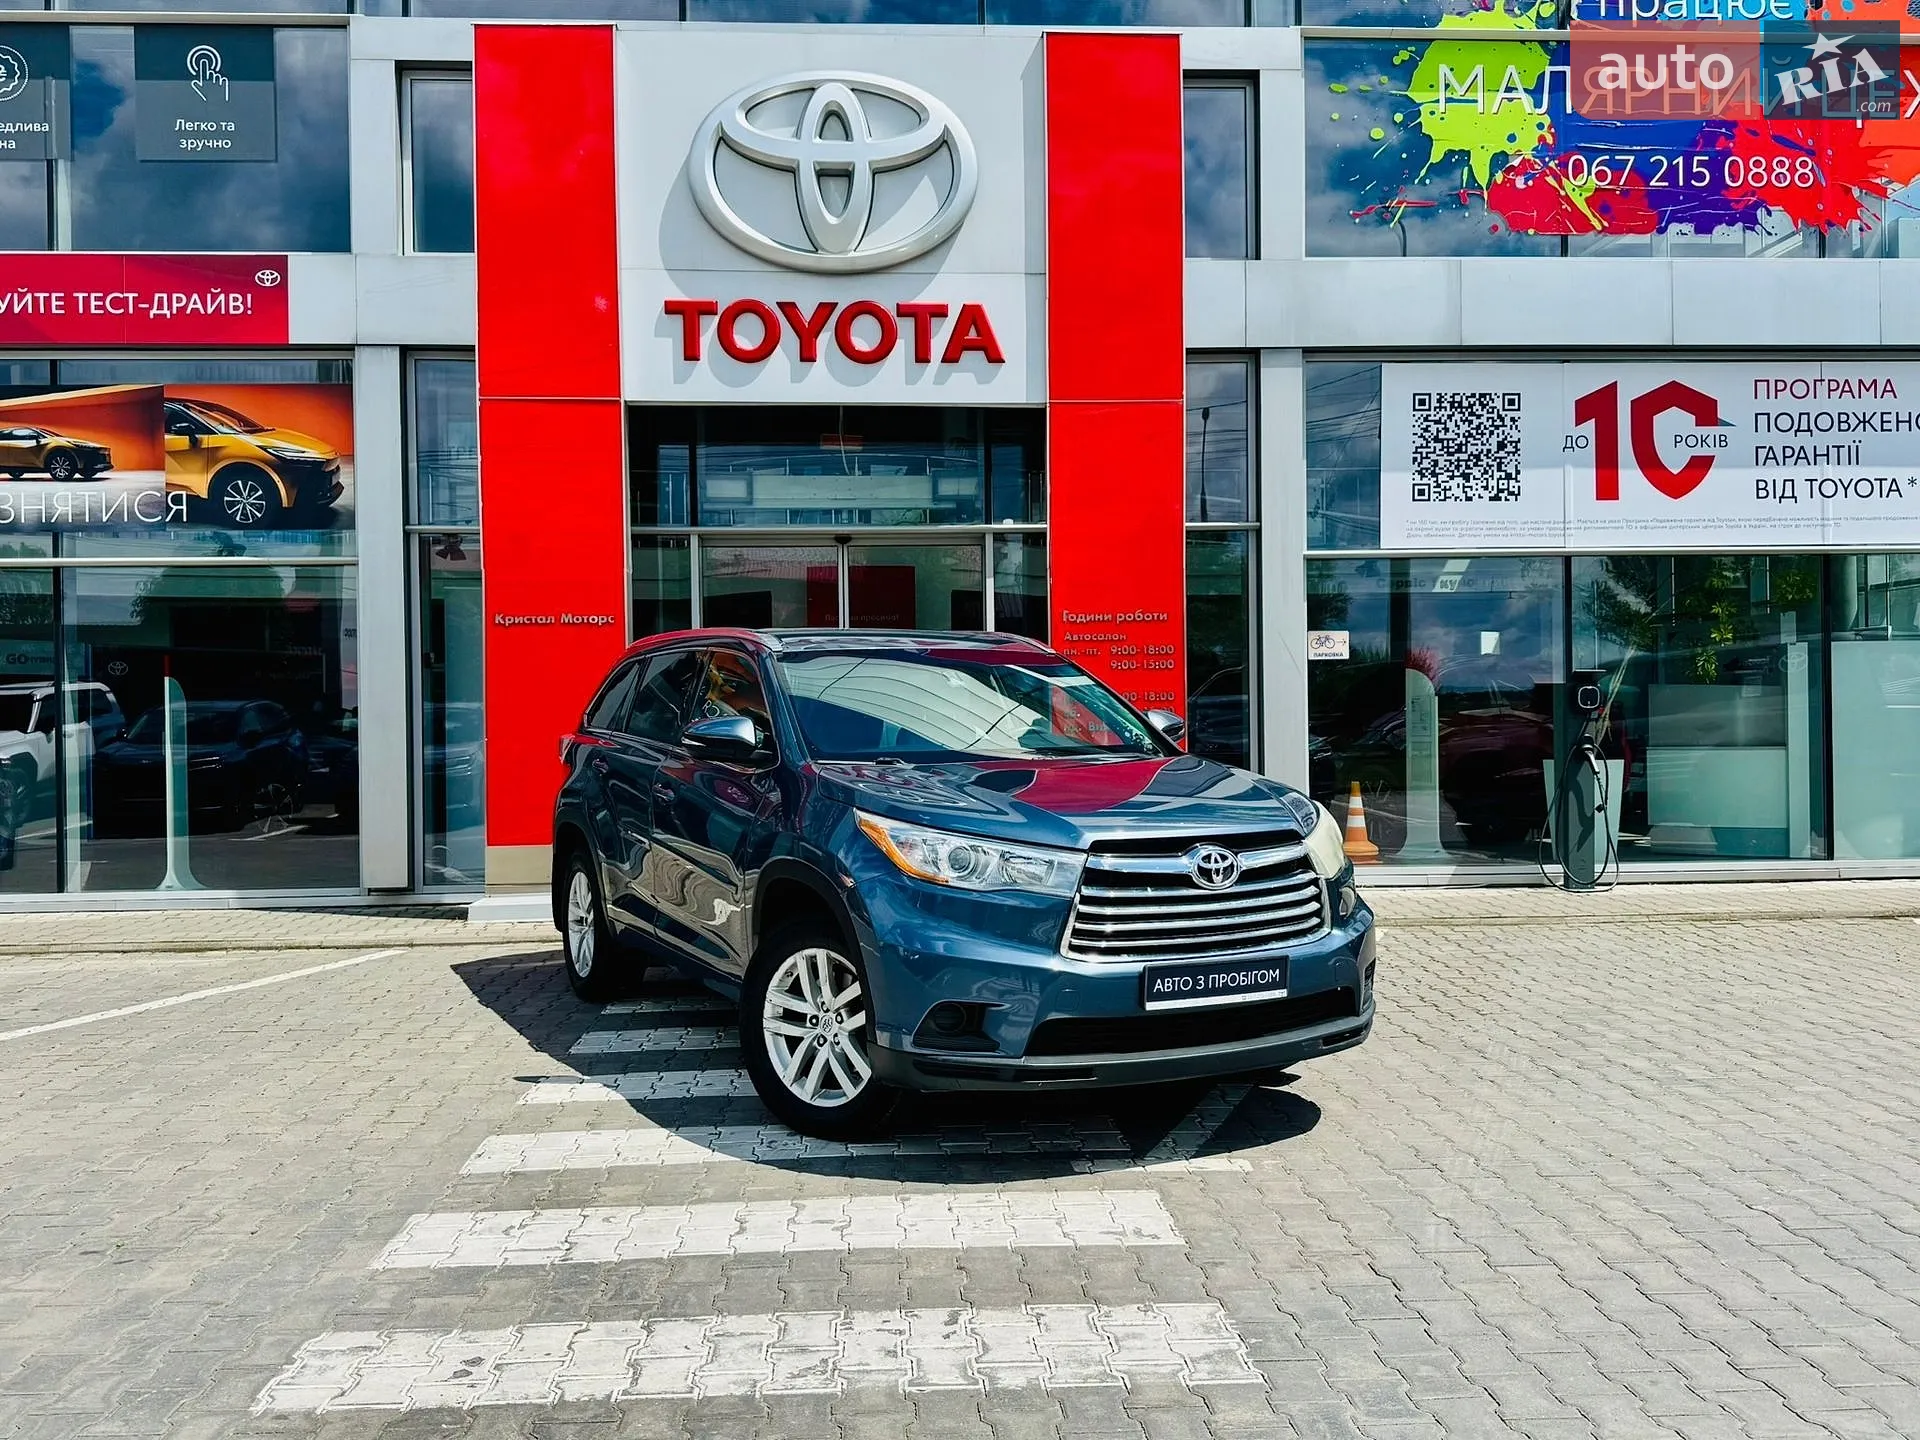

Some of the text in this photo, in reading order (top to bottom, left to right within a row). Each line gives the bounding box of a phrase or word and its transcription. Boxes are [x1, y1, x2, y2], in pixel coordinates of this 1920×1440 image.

[1437, 56, 1802, 117] МАЛЯРНИЙ
[175, 119, 235, 131] Легко та
[179, 138, 232, 151] зручно
[1567, 155, 1815, 188] 067 215 0888
[73, 287, 253, 319] ТЕСТ-ДРАЙВ!
[664, 298, 1006, 365] TOYOTA
[1753, 378, 1898, 400] ПРОГРАМА
[1754, 411, 1920, 438] ПОДОВЖЕН
[1562, 435, 1590, 453] ДО
[1673, 433, 1729, 449] РОКІВ
[1755, 439, 1862, 467] ГАРАНТІЇ
[1755, 477, 1903, 504] ВІД TOYOTA
[494, 613, 615, 626] Кристал Моторс
[1062, 609, 1168, 624] Години роботи
[1063, 632, 1127, 641] Автосалон
[1153, 968, 1280, 993] АВТО З ПРОБІГОМ
